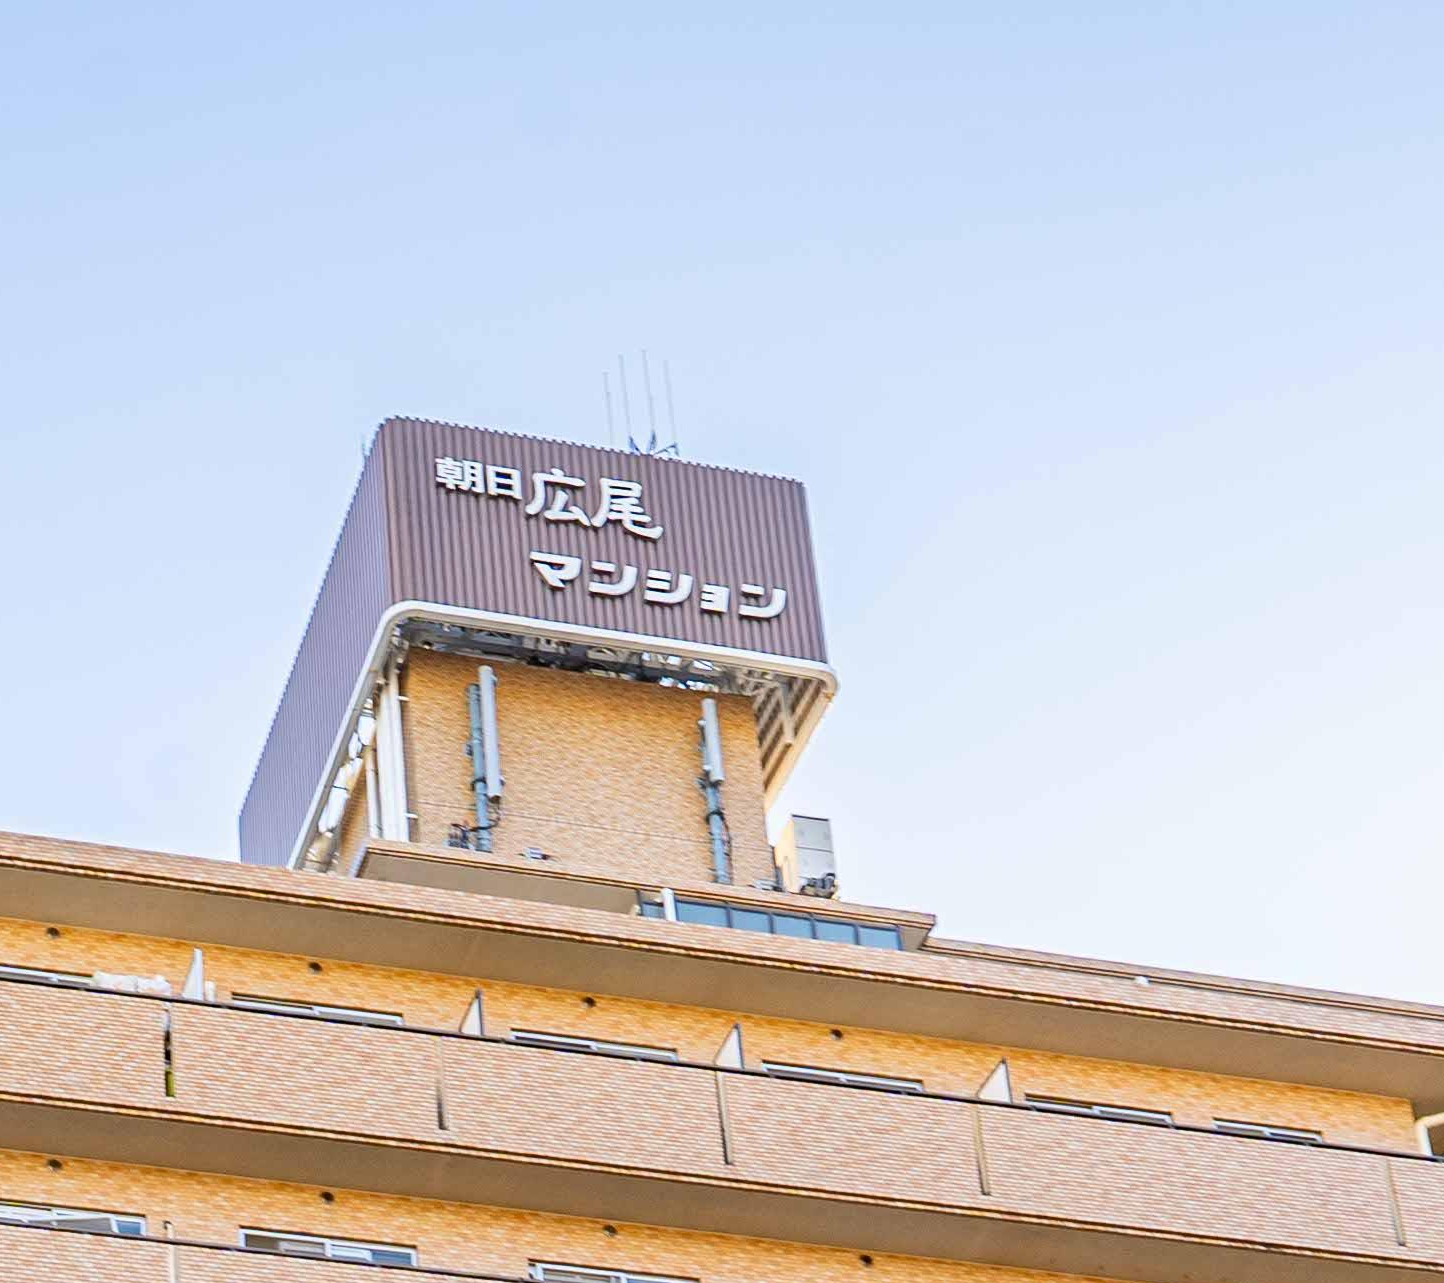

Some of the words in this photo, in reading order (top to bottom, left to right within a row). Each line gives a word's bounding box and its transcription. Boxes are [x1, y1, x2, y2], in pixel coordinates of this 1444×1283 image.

[435, 456, 664, 540] 朝日広尾
[529, 550, 787, 618] マンション
